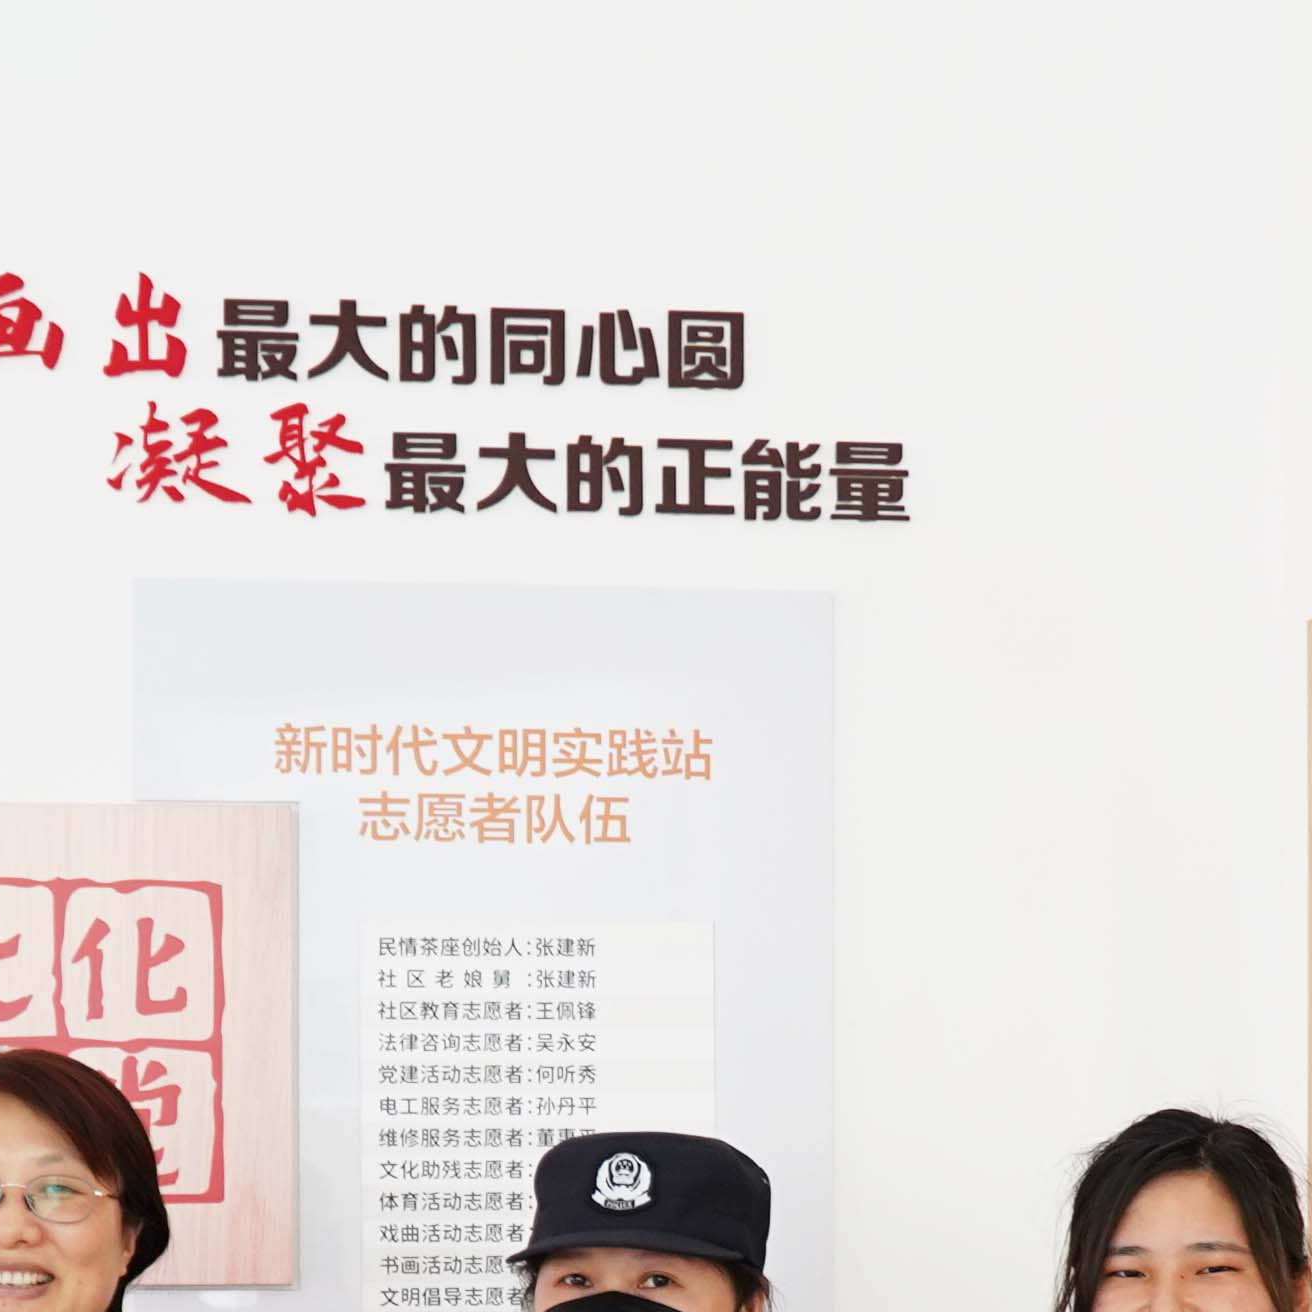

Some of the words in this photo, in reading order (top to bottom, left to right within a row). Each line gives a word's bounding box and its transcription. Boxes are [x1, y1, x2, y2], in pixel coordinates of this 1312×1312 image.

[273, 721, 714, 783] 新时代文明实践站
[358, 792, 631, 846] 志愿者队伍
[380, 1255, 518, 1275] 书画活动志愿
